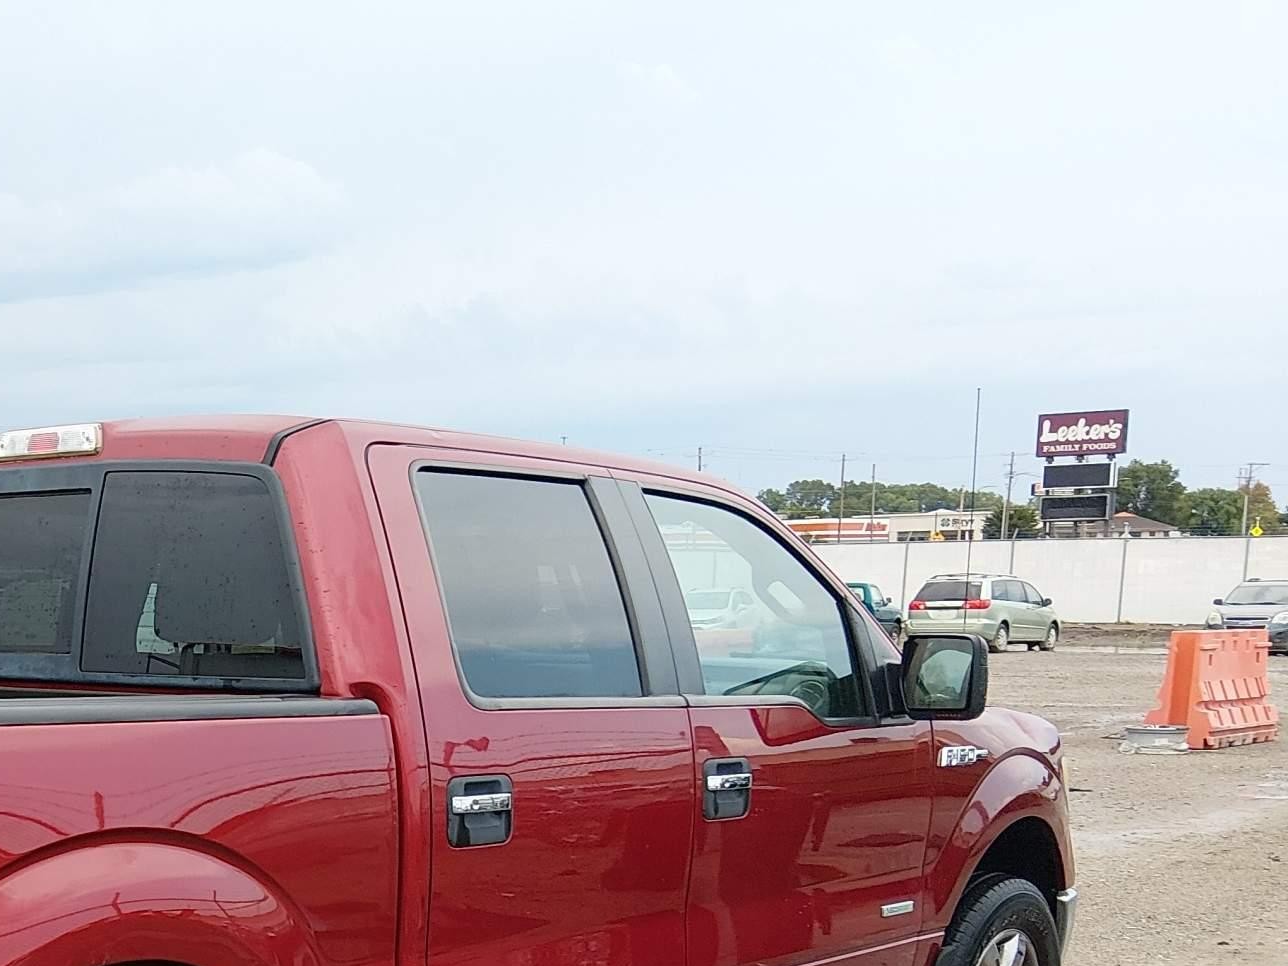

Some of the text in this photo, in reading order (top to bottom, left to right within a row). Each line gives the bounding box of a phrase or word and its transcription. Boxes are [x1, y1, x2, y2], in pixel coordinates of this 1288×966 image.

[1039, 417, 1123, 443] Leeker's
[1041, 442, 1117, 453] FAMILY FOODS
